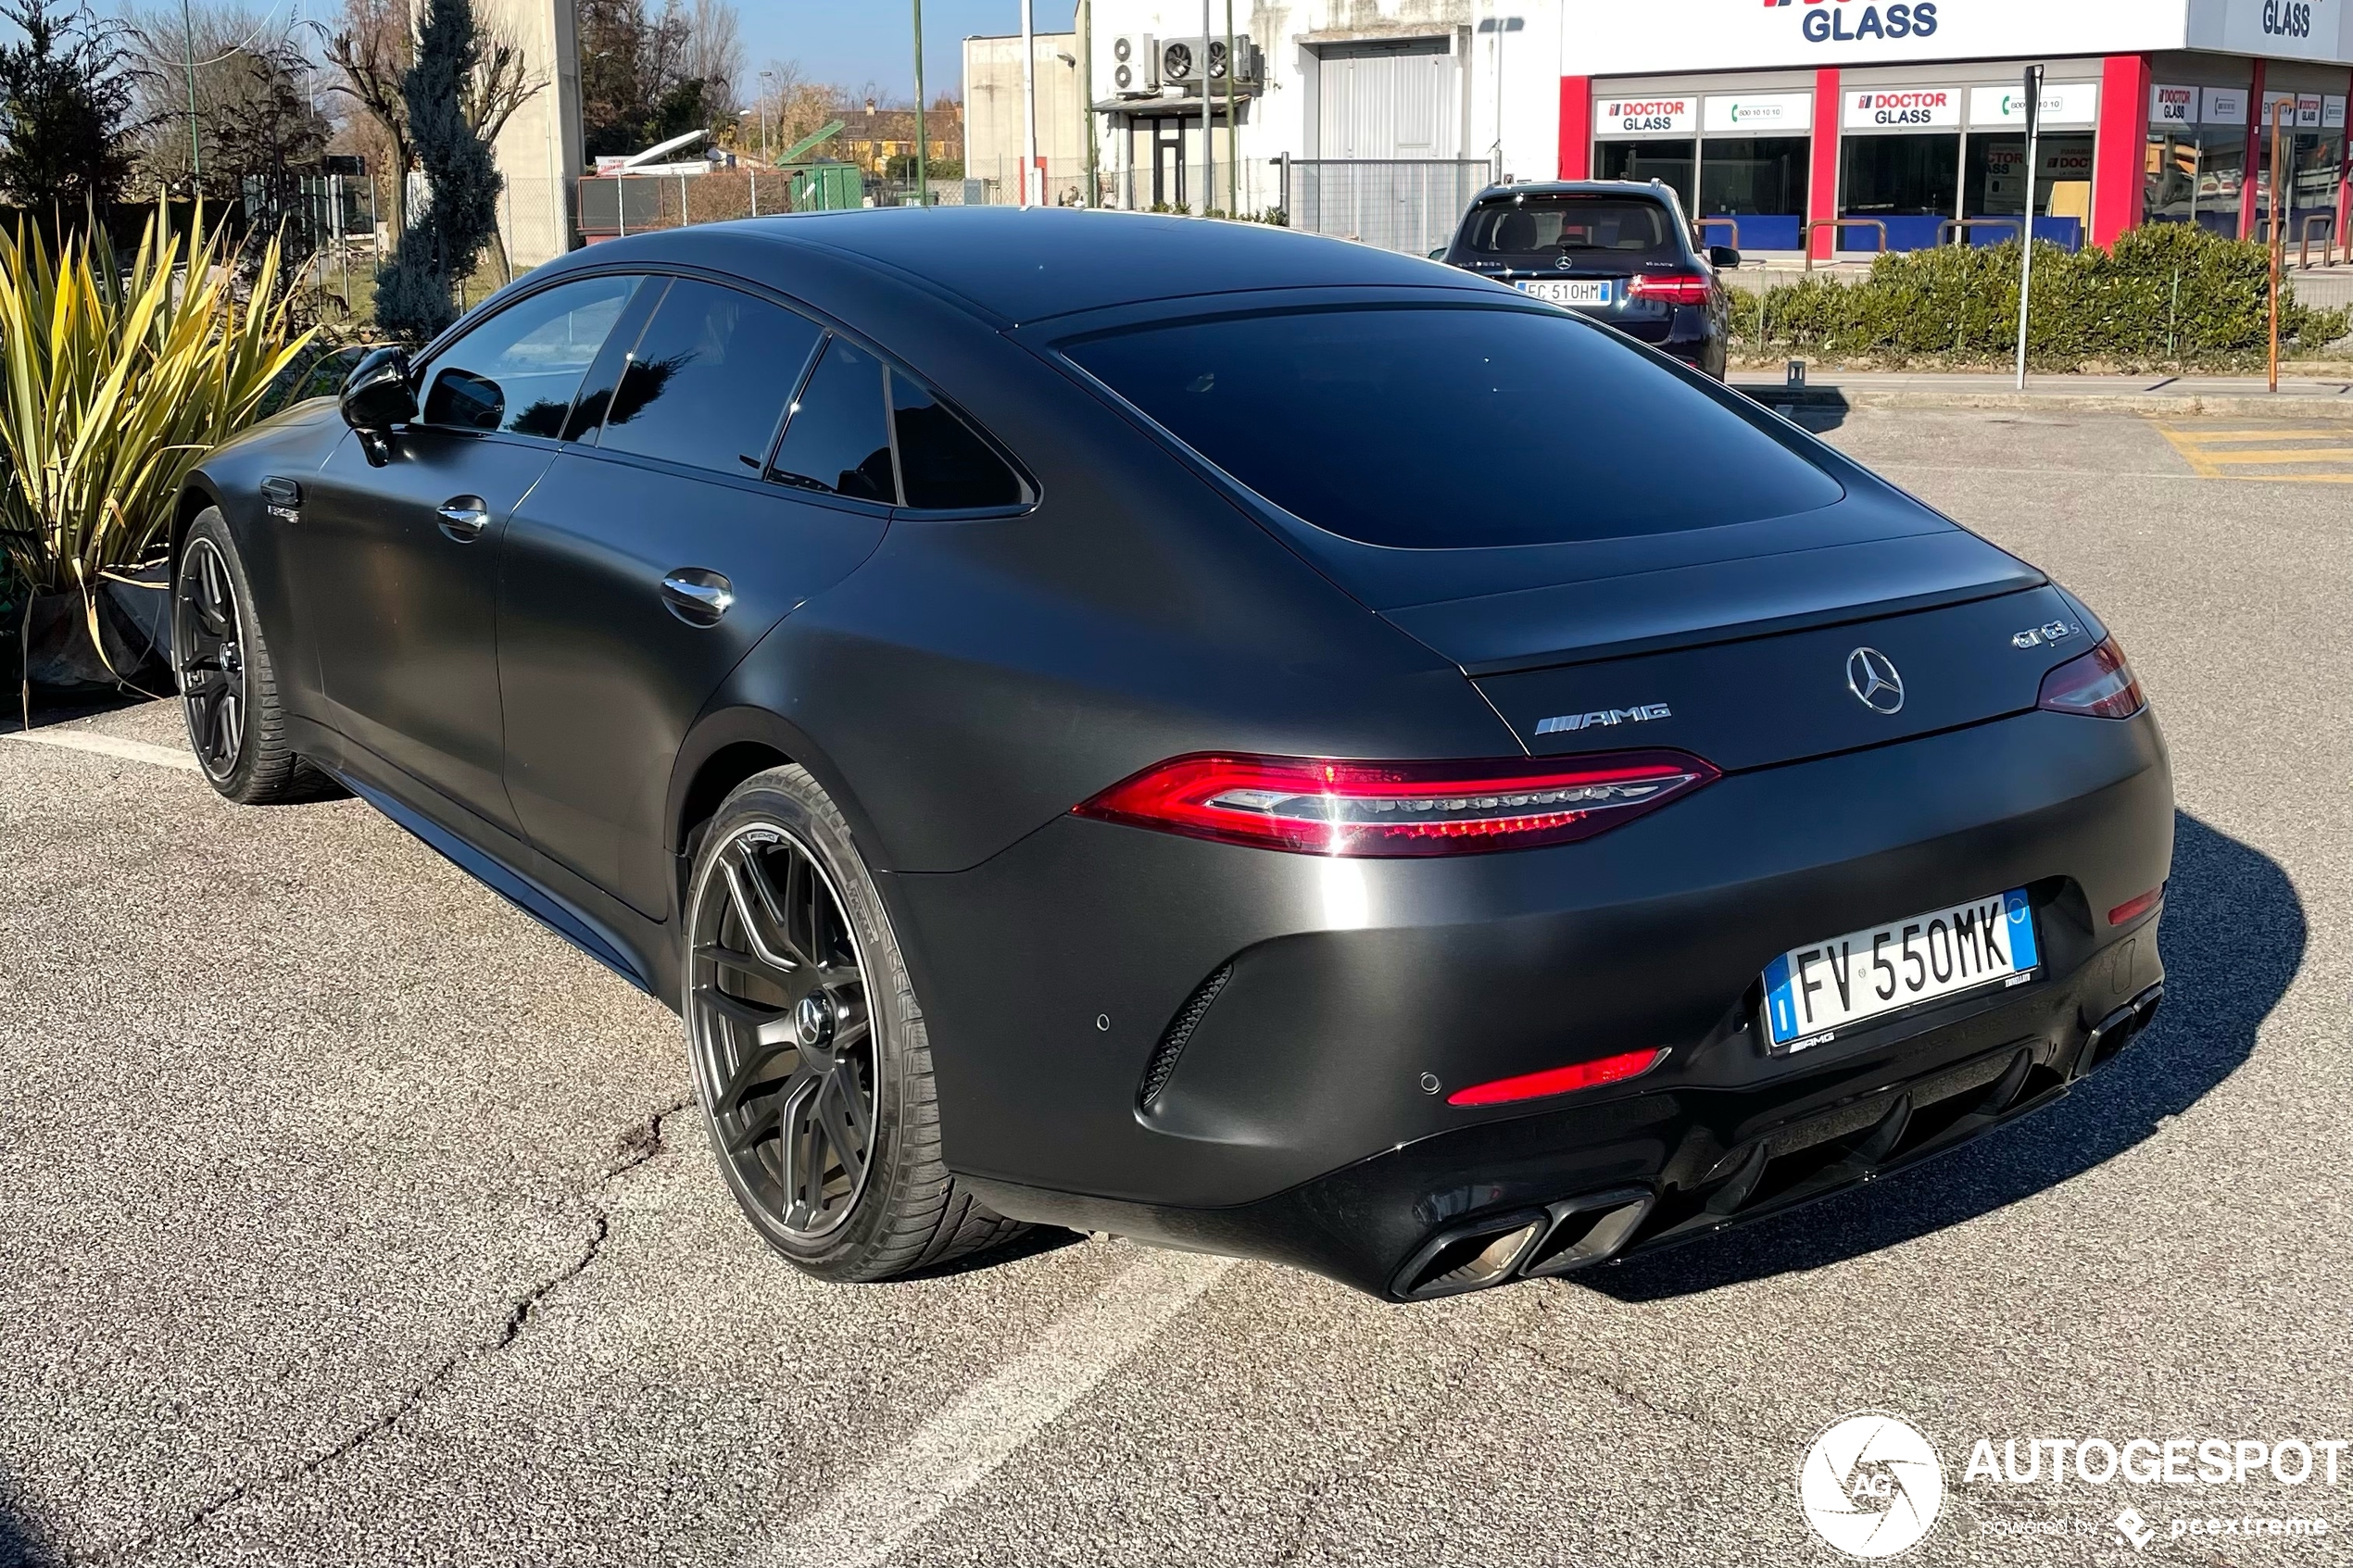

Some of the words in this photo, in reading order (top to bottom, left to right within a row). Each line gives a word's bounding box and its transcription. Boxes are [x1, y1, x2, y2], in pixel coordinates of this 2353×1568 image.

[1803, 2, 1938, 43] GLASS
[2262, 0, 2310, 38] GLASS
[1875, 93, 1947, 108] DOCTOR
[2164, 89, 2191, 104] DOCTOR
[1623, 101, 1685, 116] DOCTOR
[1874, 108, 1931, 124] GLASS
[2163, 105, 2185, 119] GLASS
[1623, 117, 1671, 131] GLASS
[2059, 157, 2090, 169] DOC
[1552, 284, 1599, 299] 510HM
[2041, 620, 2070, 641] 63
[1579, 702, 1672, 730] AMG
[1796, 941, 1851, 1023] FV
[1872, 901, 2008, 1001] 550MK
[1804, 1032, 1835, 1049] AMG
